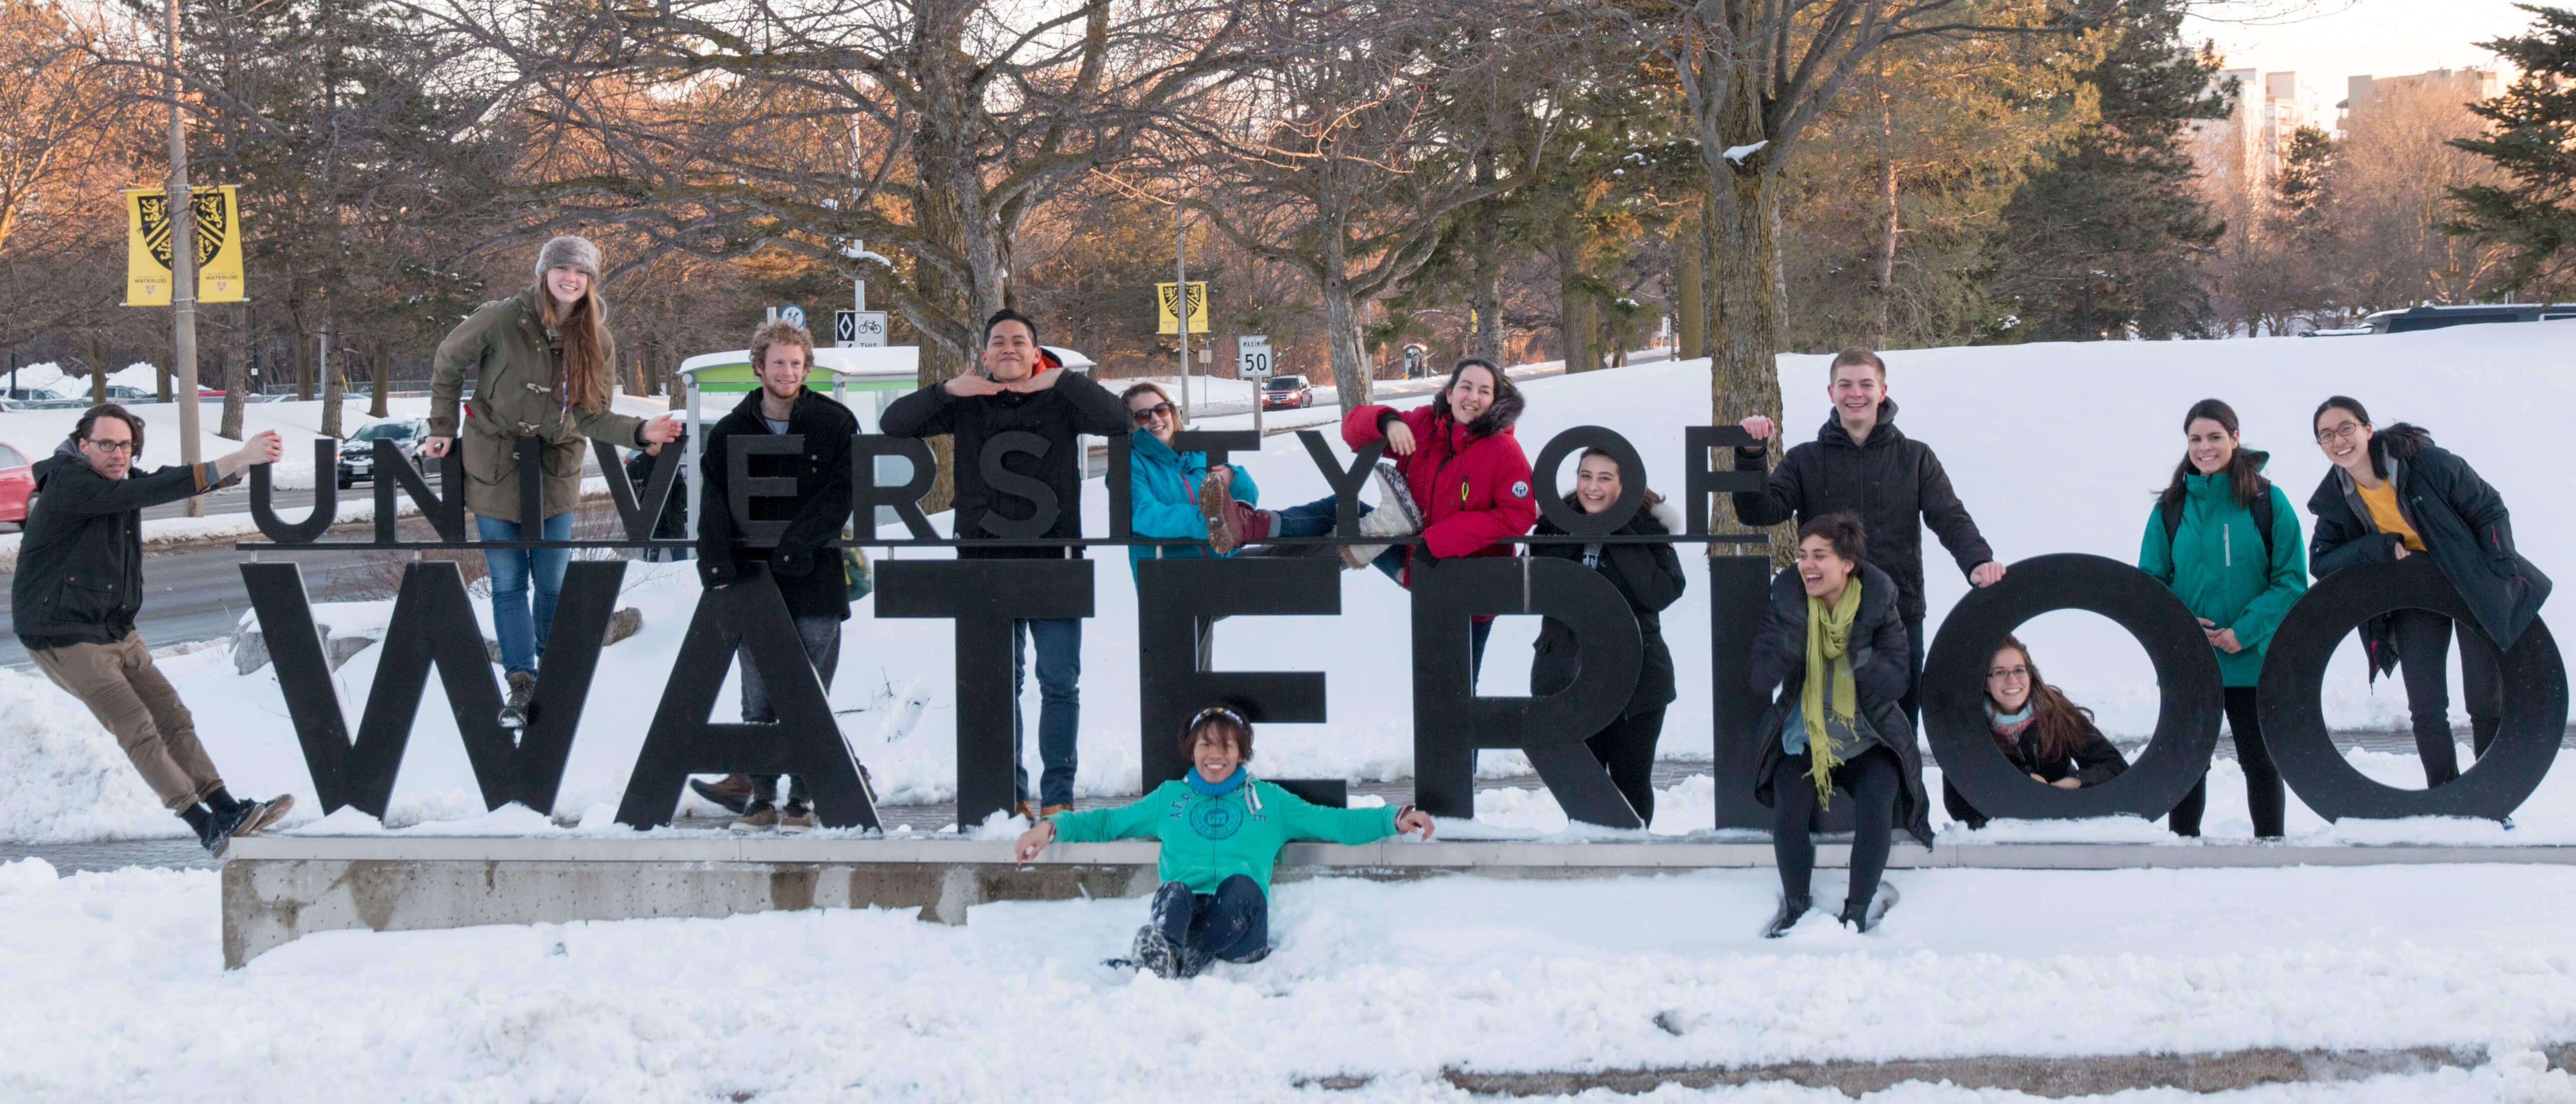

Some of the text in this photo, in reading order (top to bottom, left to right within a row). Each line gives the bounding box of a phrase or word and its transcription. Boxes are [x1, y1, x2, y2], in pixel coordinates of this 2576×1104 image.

[1245, 353, 1266, 371] 50
[250, 425, 1768, 541] UNIVERSITY OF
[239, 552, 2569, 833] WATERLOO
